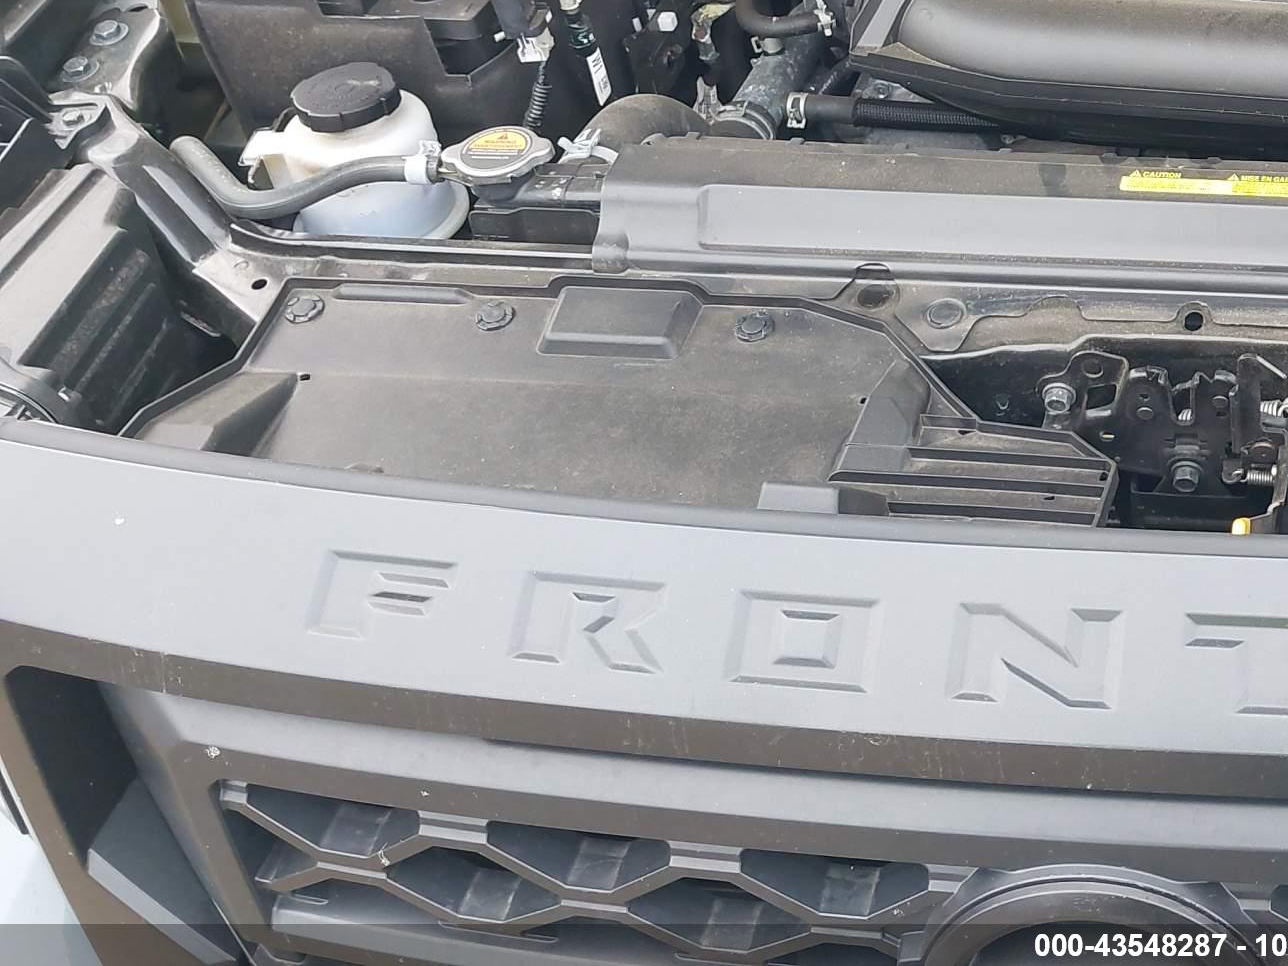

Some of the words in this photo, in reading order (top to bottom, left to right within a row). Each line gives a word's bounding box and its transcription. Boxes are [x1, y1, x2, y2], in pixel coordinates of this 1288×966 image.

[1142, 171, 1182, 179] CAUTION
[1240, 174, 1260, 183] MISE
[1261, 175, 1273, 183] EN
